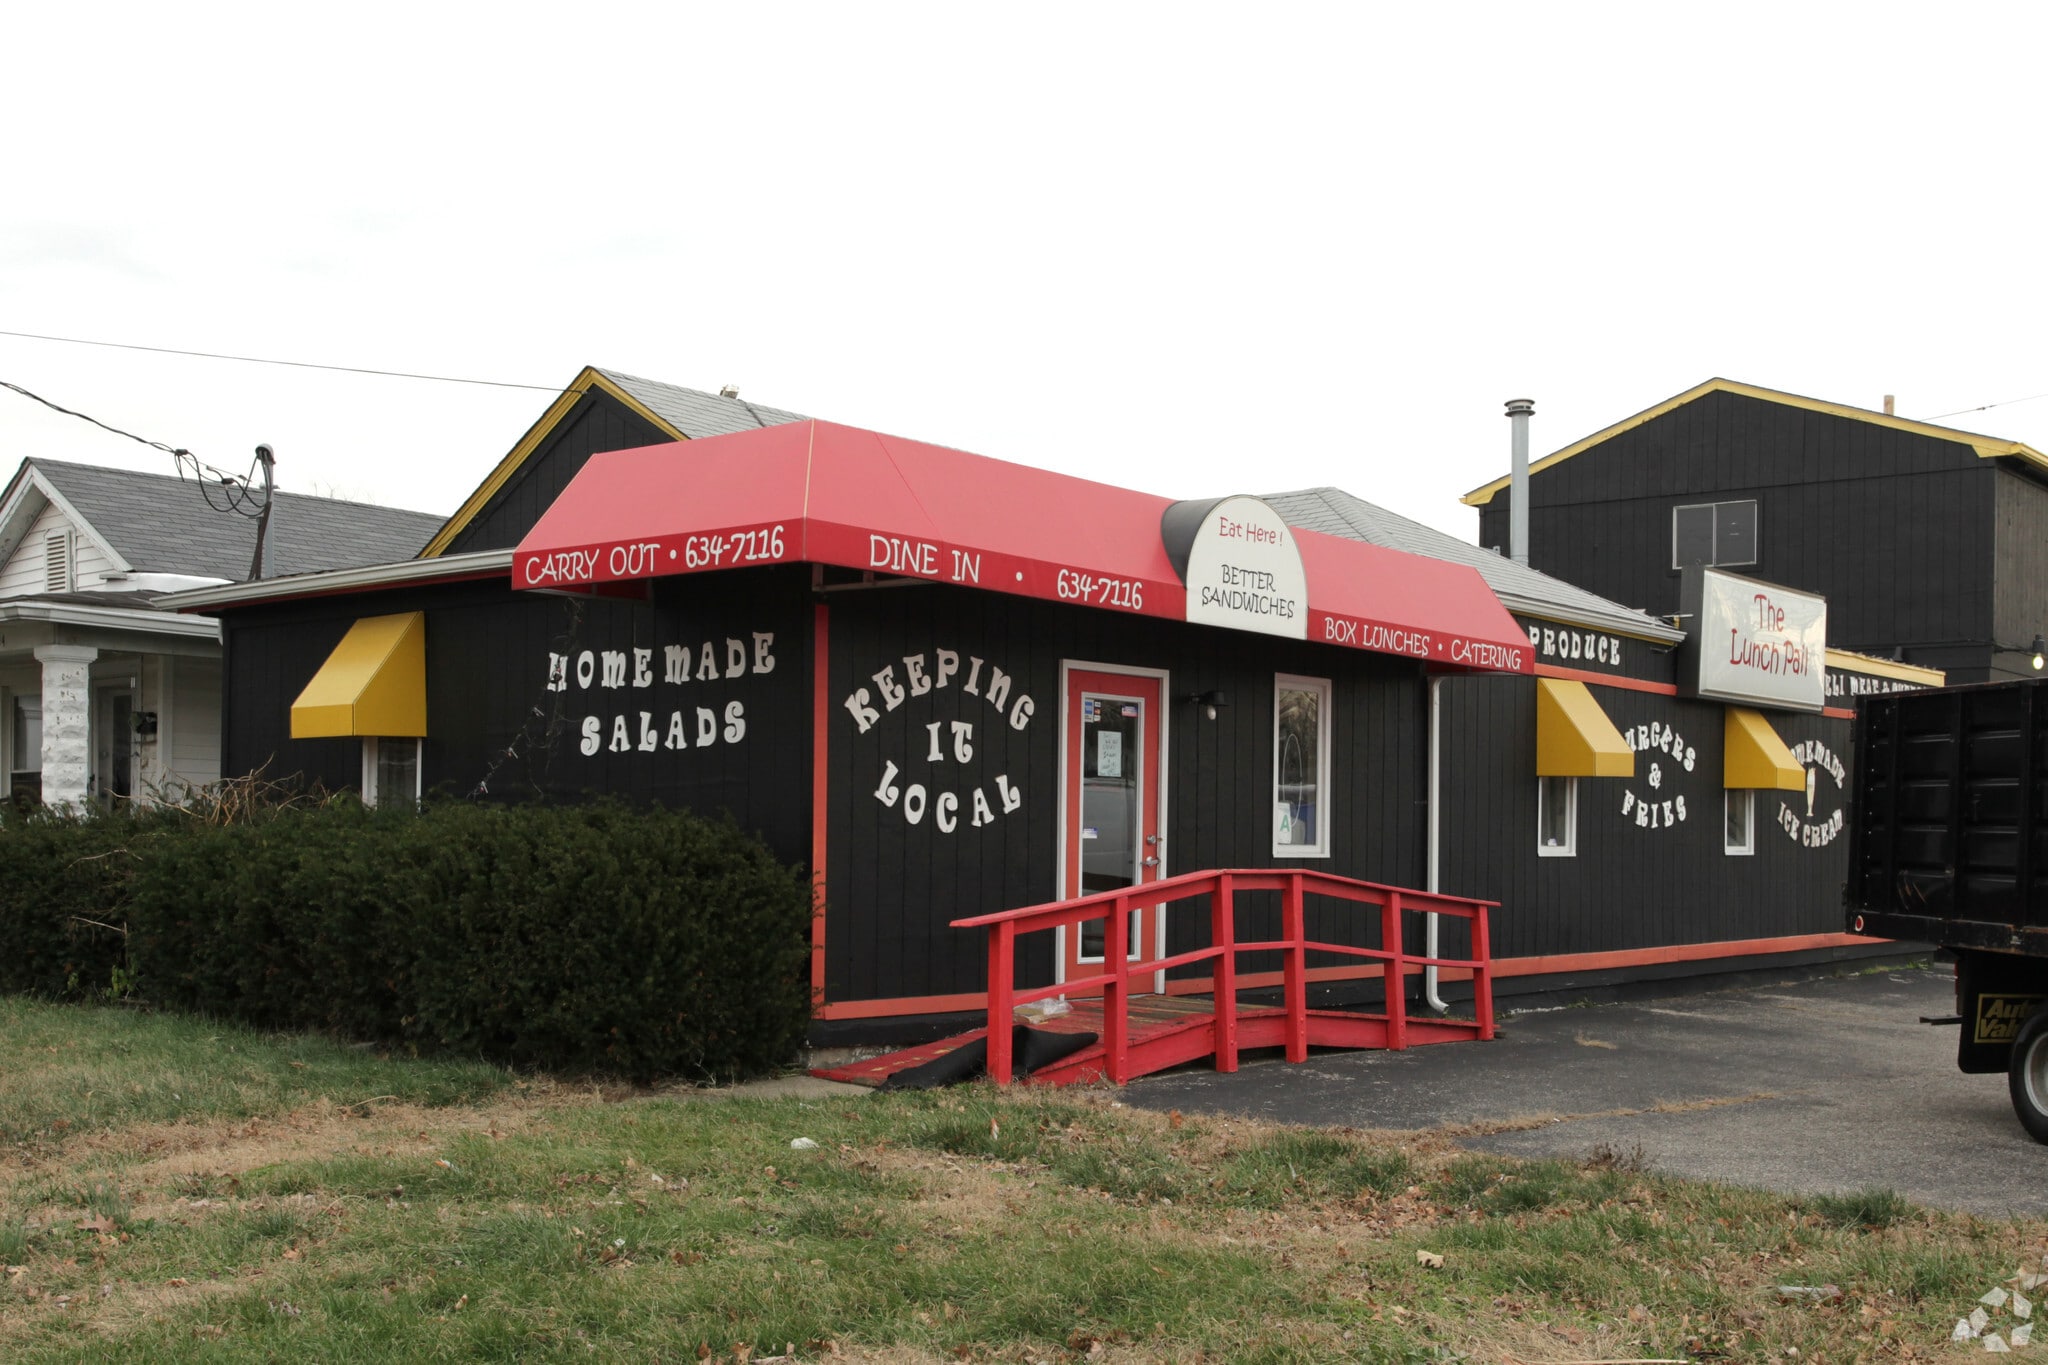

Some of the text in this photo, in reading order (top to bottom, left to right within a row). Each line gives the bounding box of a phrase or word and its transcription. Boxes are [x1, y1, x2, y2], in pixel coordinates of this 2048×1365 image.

[1219, 516, 1243, 538] Eat
[525, 525, 784, 584] CARRY OUT 634-7116
[869, 534, 1143, 610] DINE IN 634-7116
[1221, 564, 1276, 592] BETTER
[1202, 586, 1295, 619] SANDWICHES
[1754, 593, 1785, 632] The
[1324, 616, 1521, 670] BOX LUNCHES CATERING
[1528, 625, 1620, 665] PRODUCE
[1730, 628, 1809, 677] Lunch Pail
[844, 648, 1035, 733] KEEPING
[1825, 673, 1845, 696] ELI
[580, 700, 746, 757] SALADS
[926, 720, 973, 764] IT
[1624, 721, 1696, 772] URGERS
[1648, 762, 1662, 790] &
[1790, 740, 1846, 789] MEMADE
[874, 760, 1021, 833] LOCAL
[1621, 789, 1686, 829] FRIES
[1777, 801, 1843, 848] ICE CREAM
